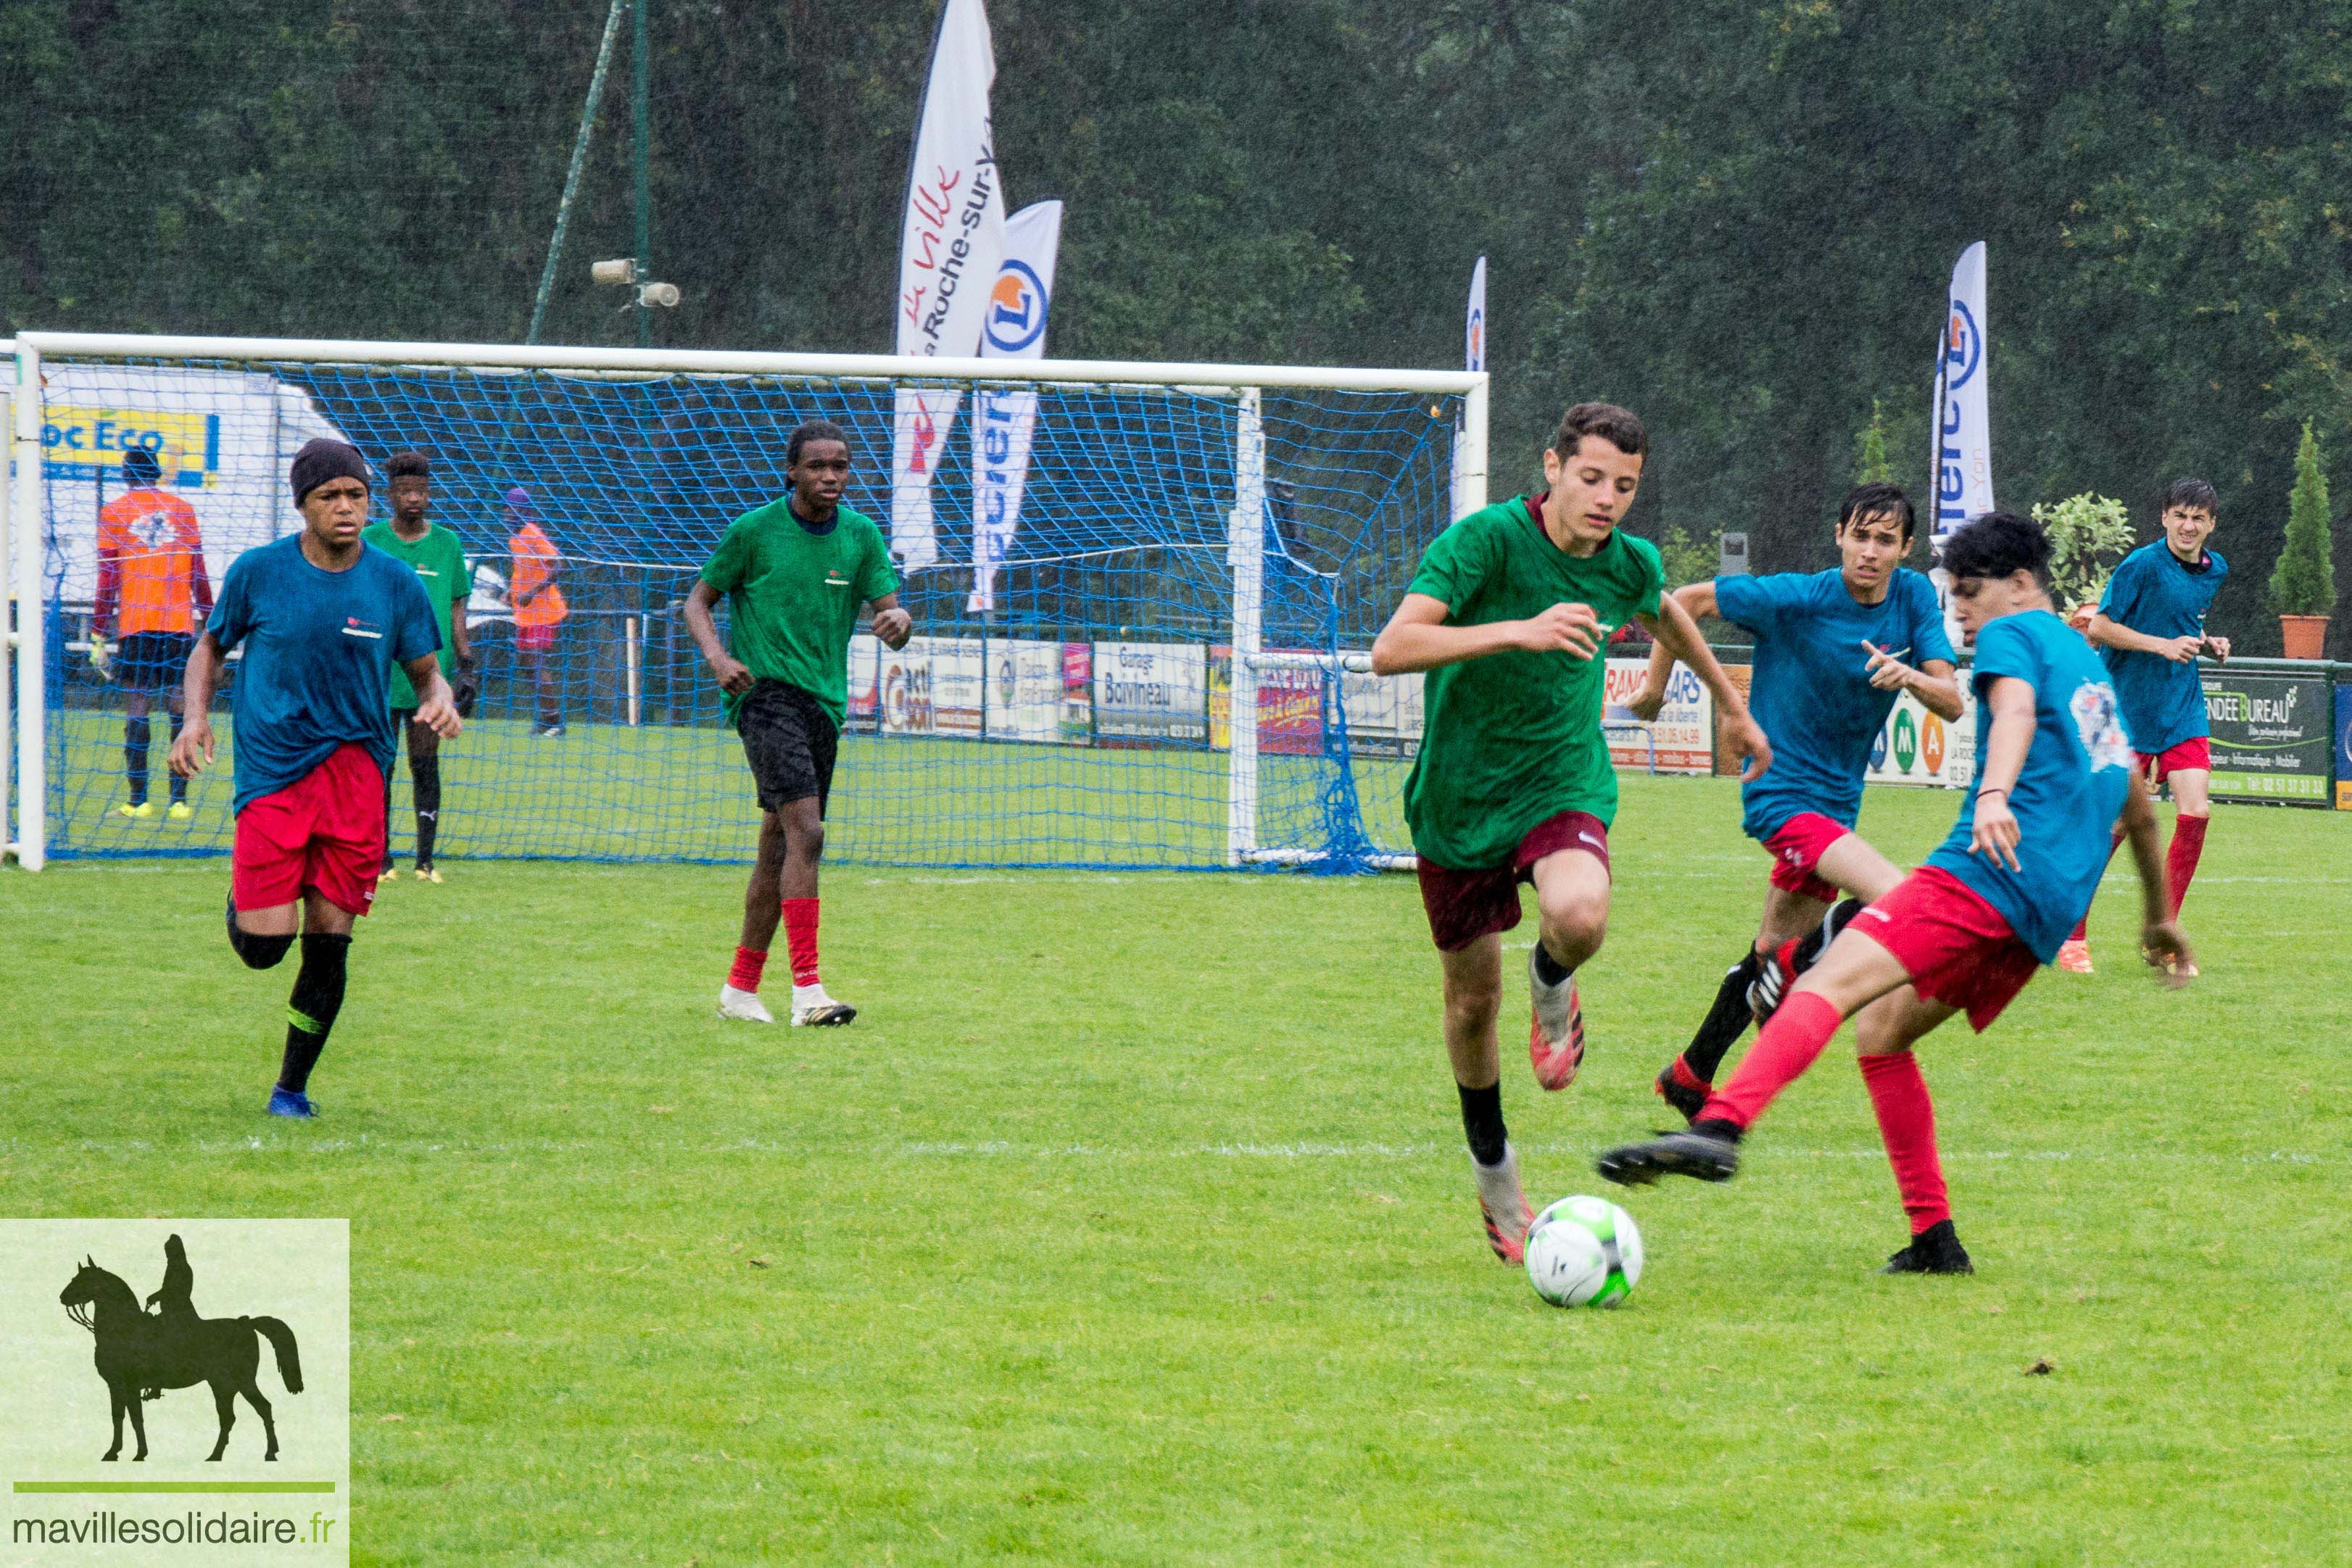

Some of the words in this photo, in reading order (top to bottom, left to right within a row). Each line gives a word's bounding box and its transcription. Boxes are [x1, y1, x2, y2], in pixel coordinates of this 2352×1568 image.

[913, 165, 961, 270] ville
[923, 117, 995, 340] Roche-sur-Y
[40, 424, 83, 449] oc
[95, 420, 164, 454] Eco
